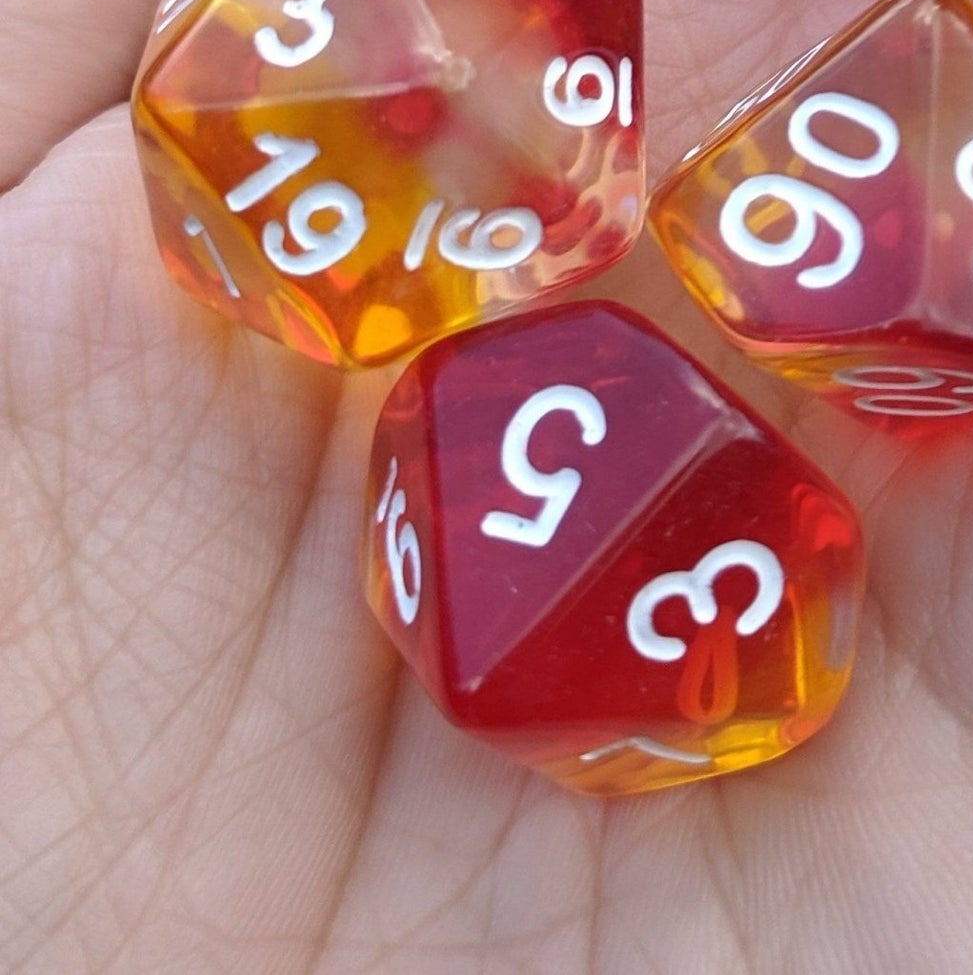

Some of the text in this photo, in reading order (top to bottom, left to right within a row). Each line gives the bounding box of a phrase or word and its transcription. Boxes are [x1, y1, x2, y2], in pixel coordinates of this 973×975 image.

[542, 54, 633, 127] 6
[225, 131, 366, 275] 19
[719, 91, 900, 289] 90
[481, 384, 607, 547] 5
[627, 539, 784, 662] 3
